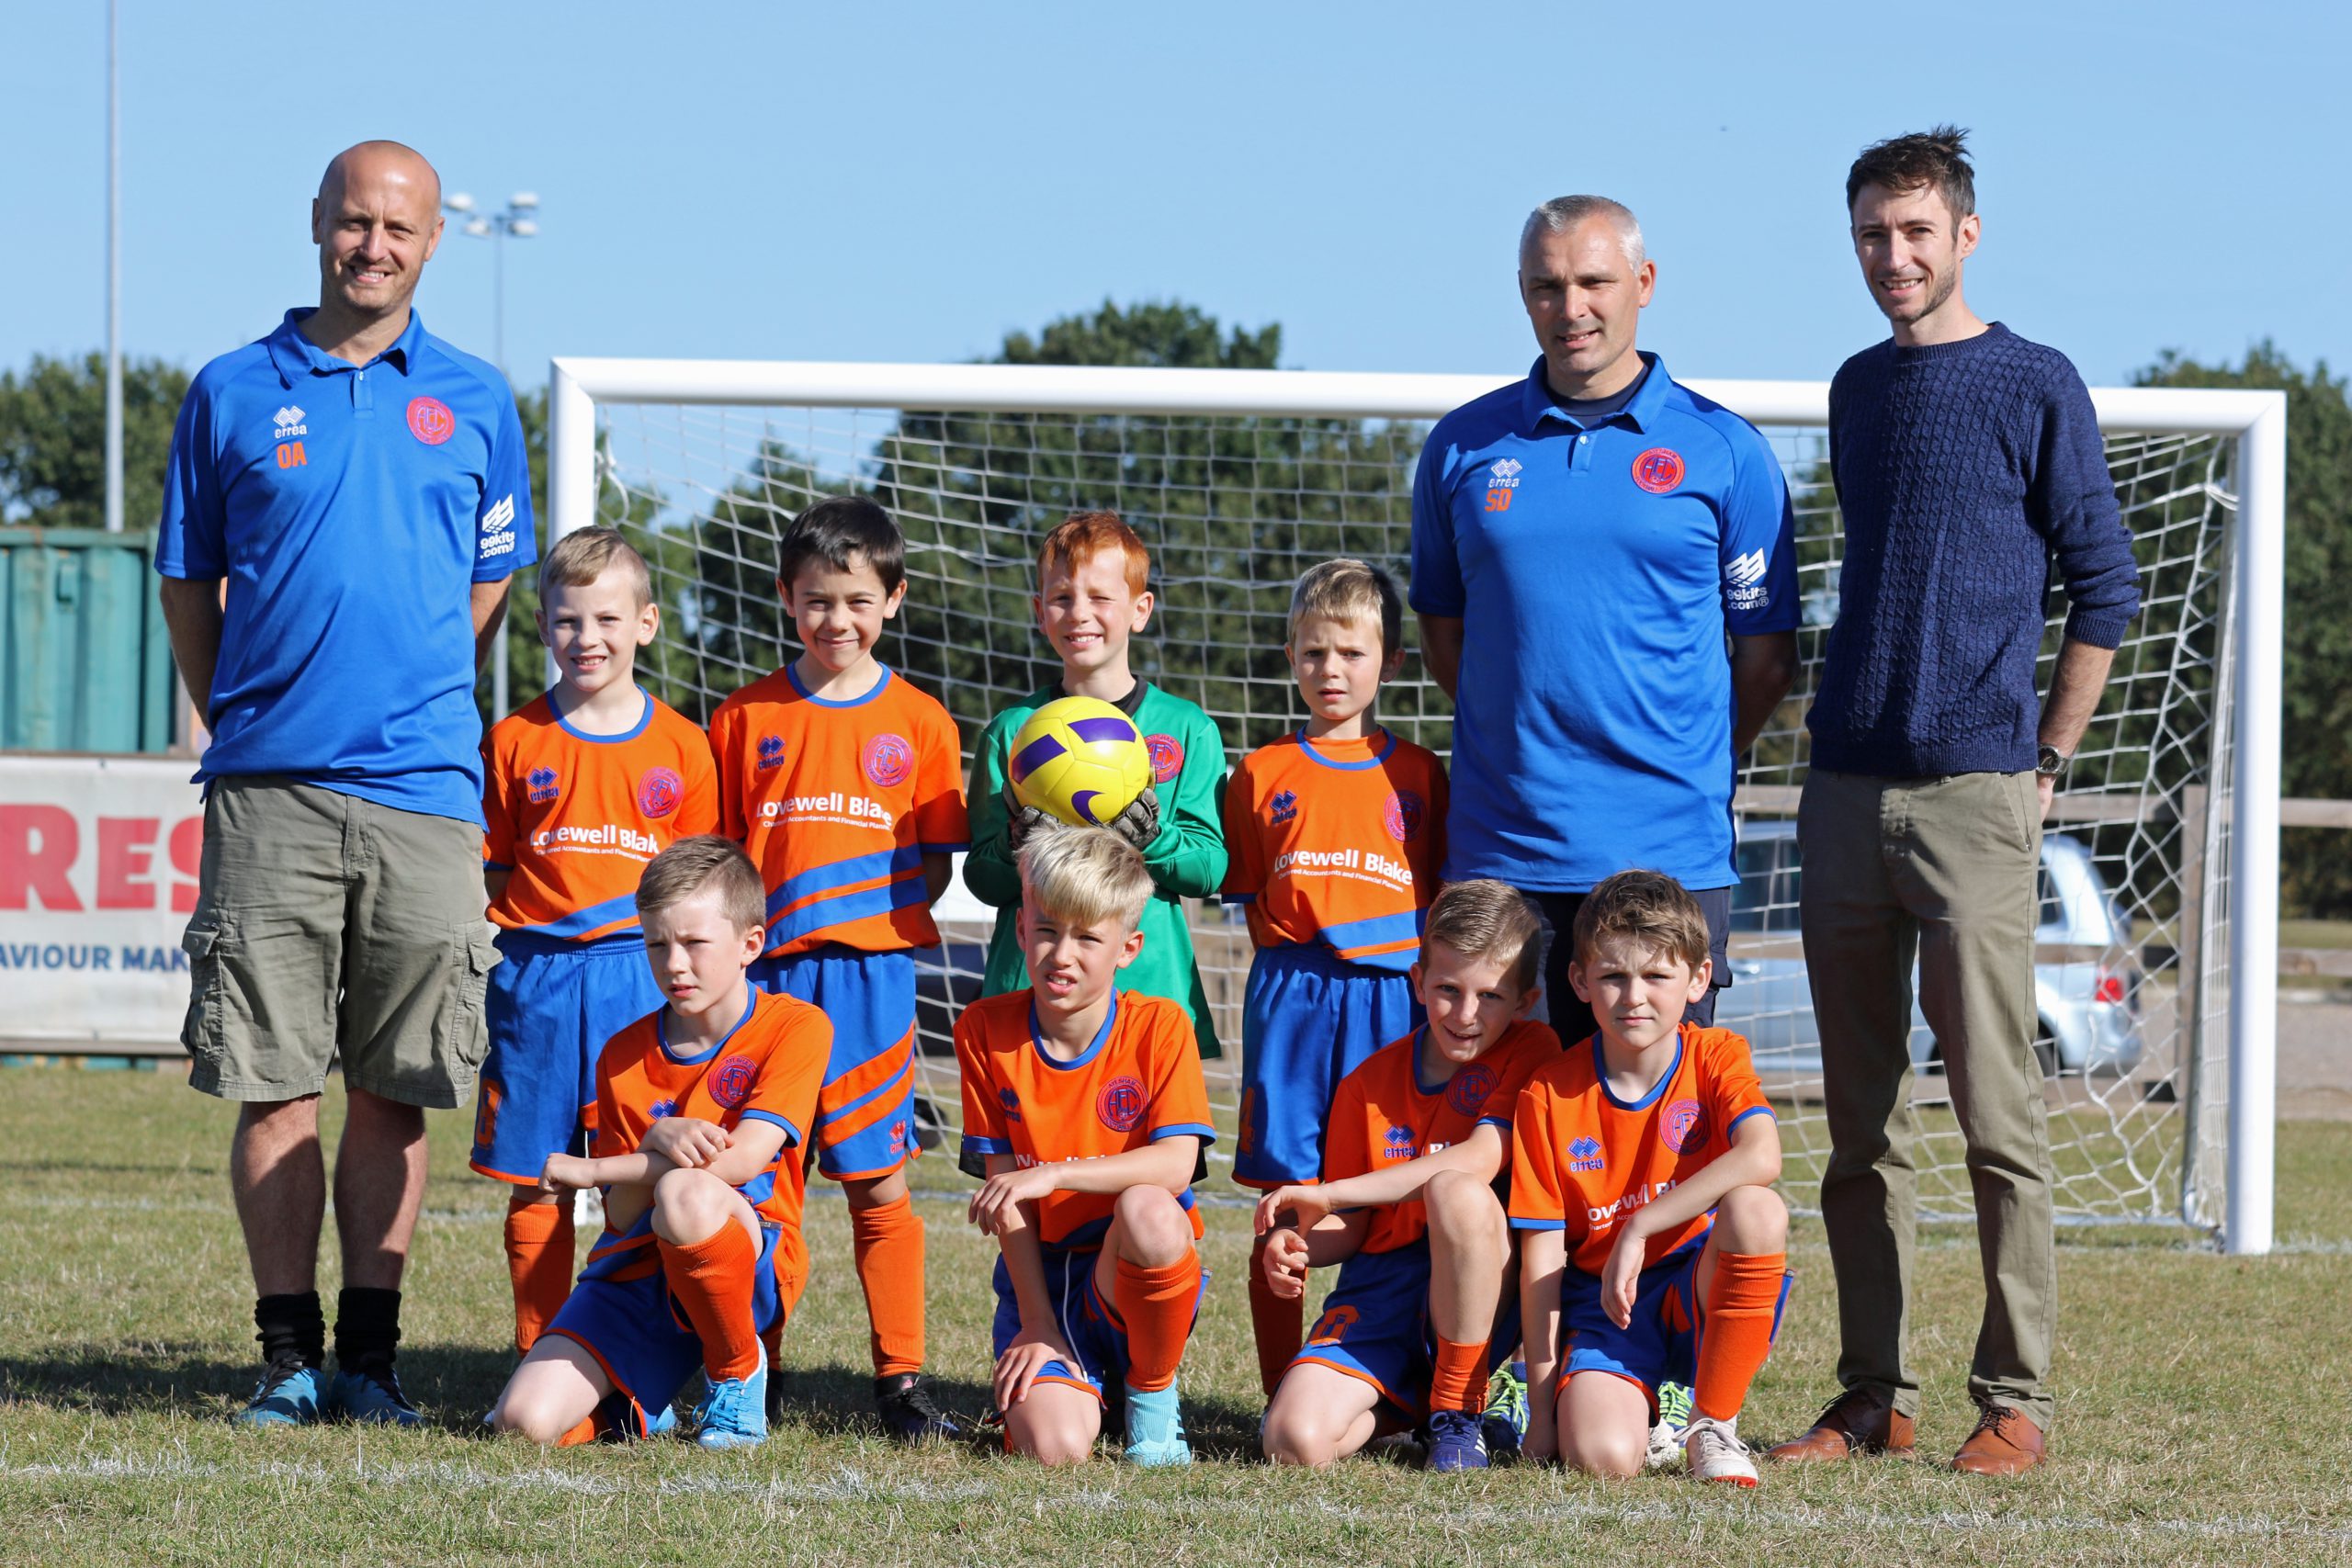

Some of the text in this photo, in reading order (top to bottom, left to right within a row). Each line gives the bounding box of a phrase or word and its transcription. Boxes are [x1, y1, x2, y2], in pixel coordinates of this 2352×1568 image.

[277, 442, 308, 469] OA
[1484, 488, 1513, 512] SD
[1726, 586, 1769, 601] 99kits
[757, 792, 893, 827] Lovewell Blae
[530, 824, 616, 846] Lovewell
[1274, 848, 1413, 886] Lovewell Blake
